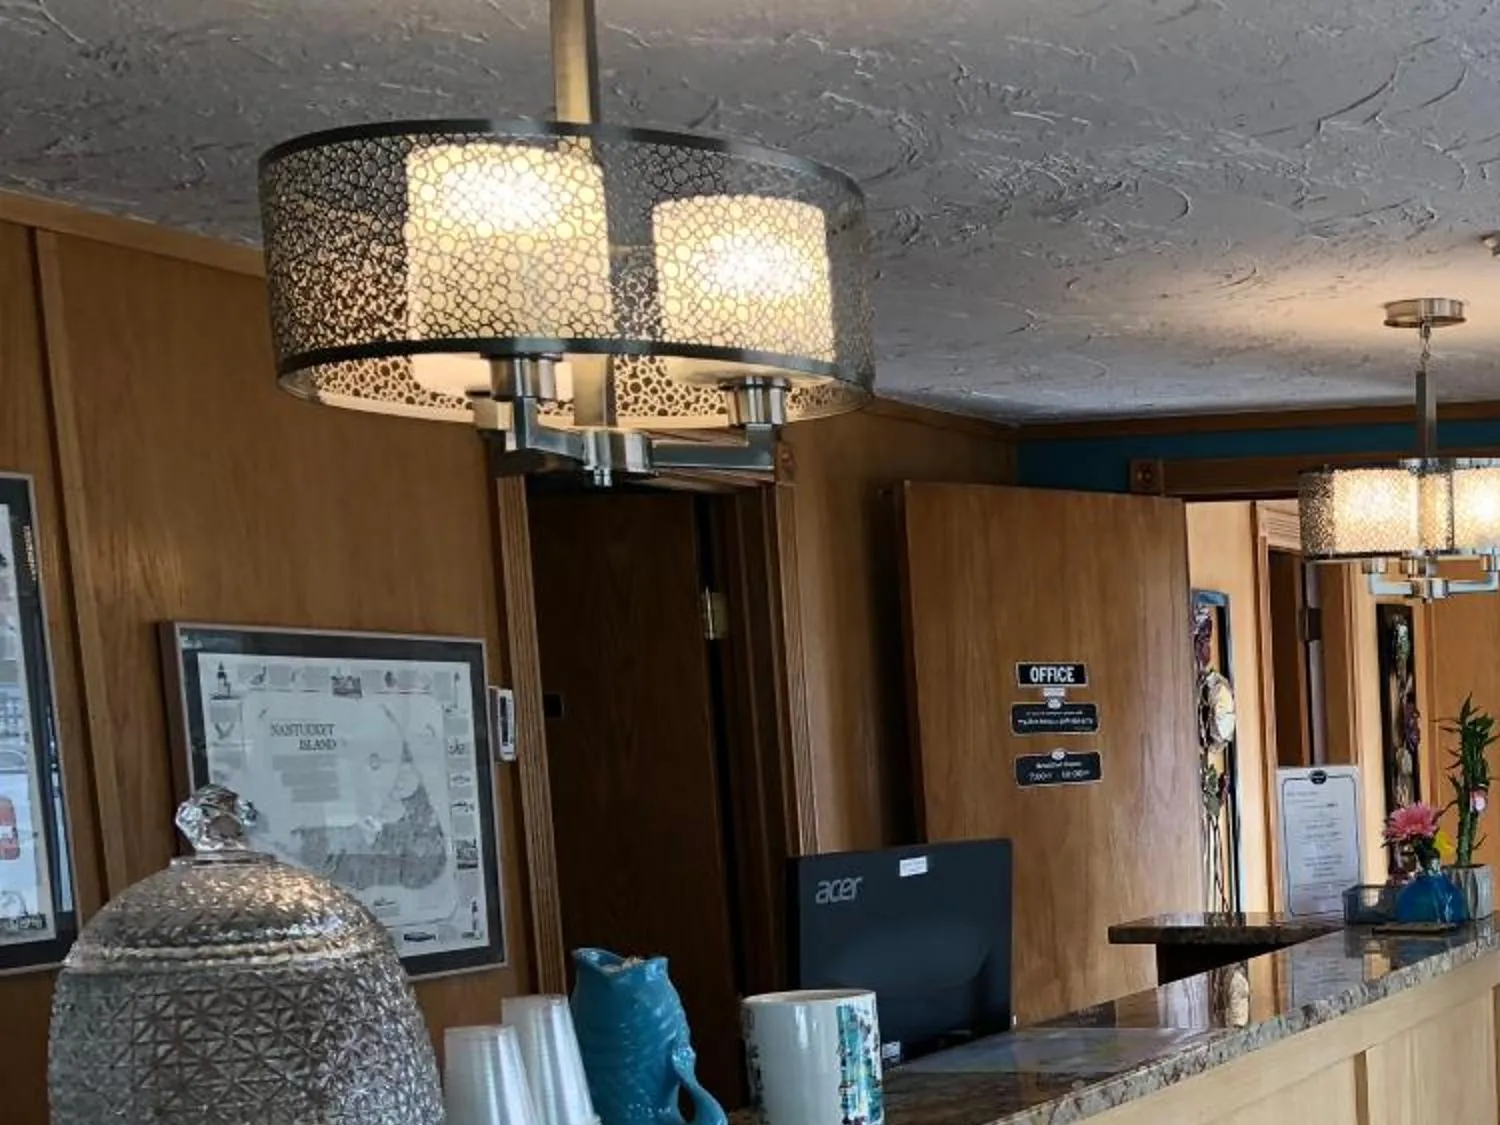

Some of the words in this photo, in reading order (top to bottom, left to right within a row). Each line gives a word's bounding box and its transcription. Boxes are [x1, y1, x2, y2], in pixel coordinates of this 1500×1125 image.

[1030, 666, 1075, 683] OFFICE
[270, 723, 336, 737] NANTUCKET
[299, 739, 337, 751] ISLAND
[815, 876, 864, 904] acer
